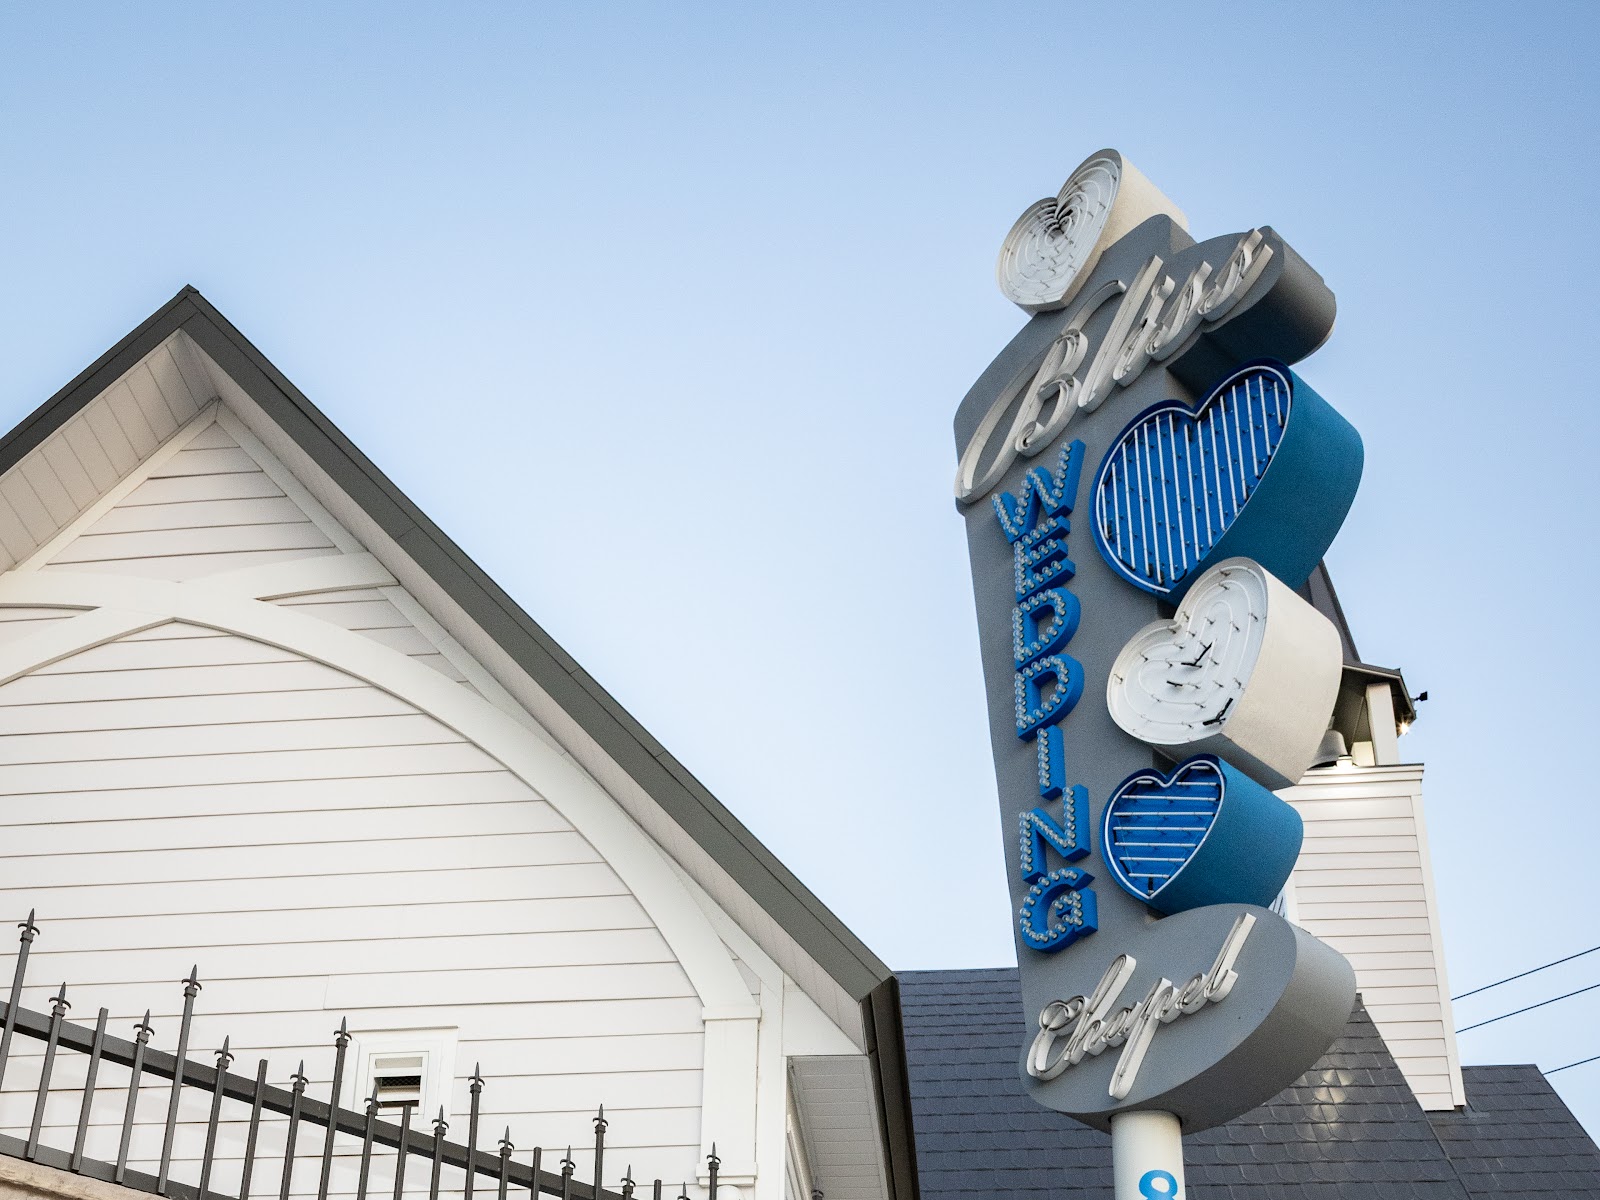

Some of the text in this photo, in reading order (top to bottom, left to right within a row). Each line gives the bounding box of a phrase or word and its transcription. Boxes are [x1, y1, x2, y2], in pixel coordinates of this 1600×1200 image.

[954, 227, 1274, 504] Bliss
[992, 439, 1098, 954] WEDDING
[1026, 912, 1257, 1100] Chapel
